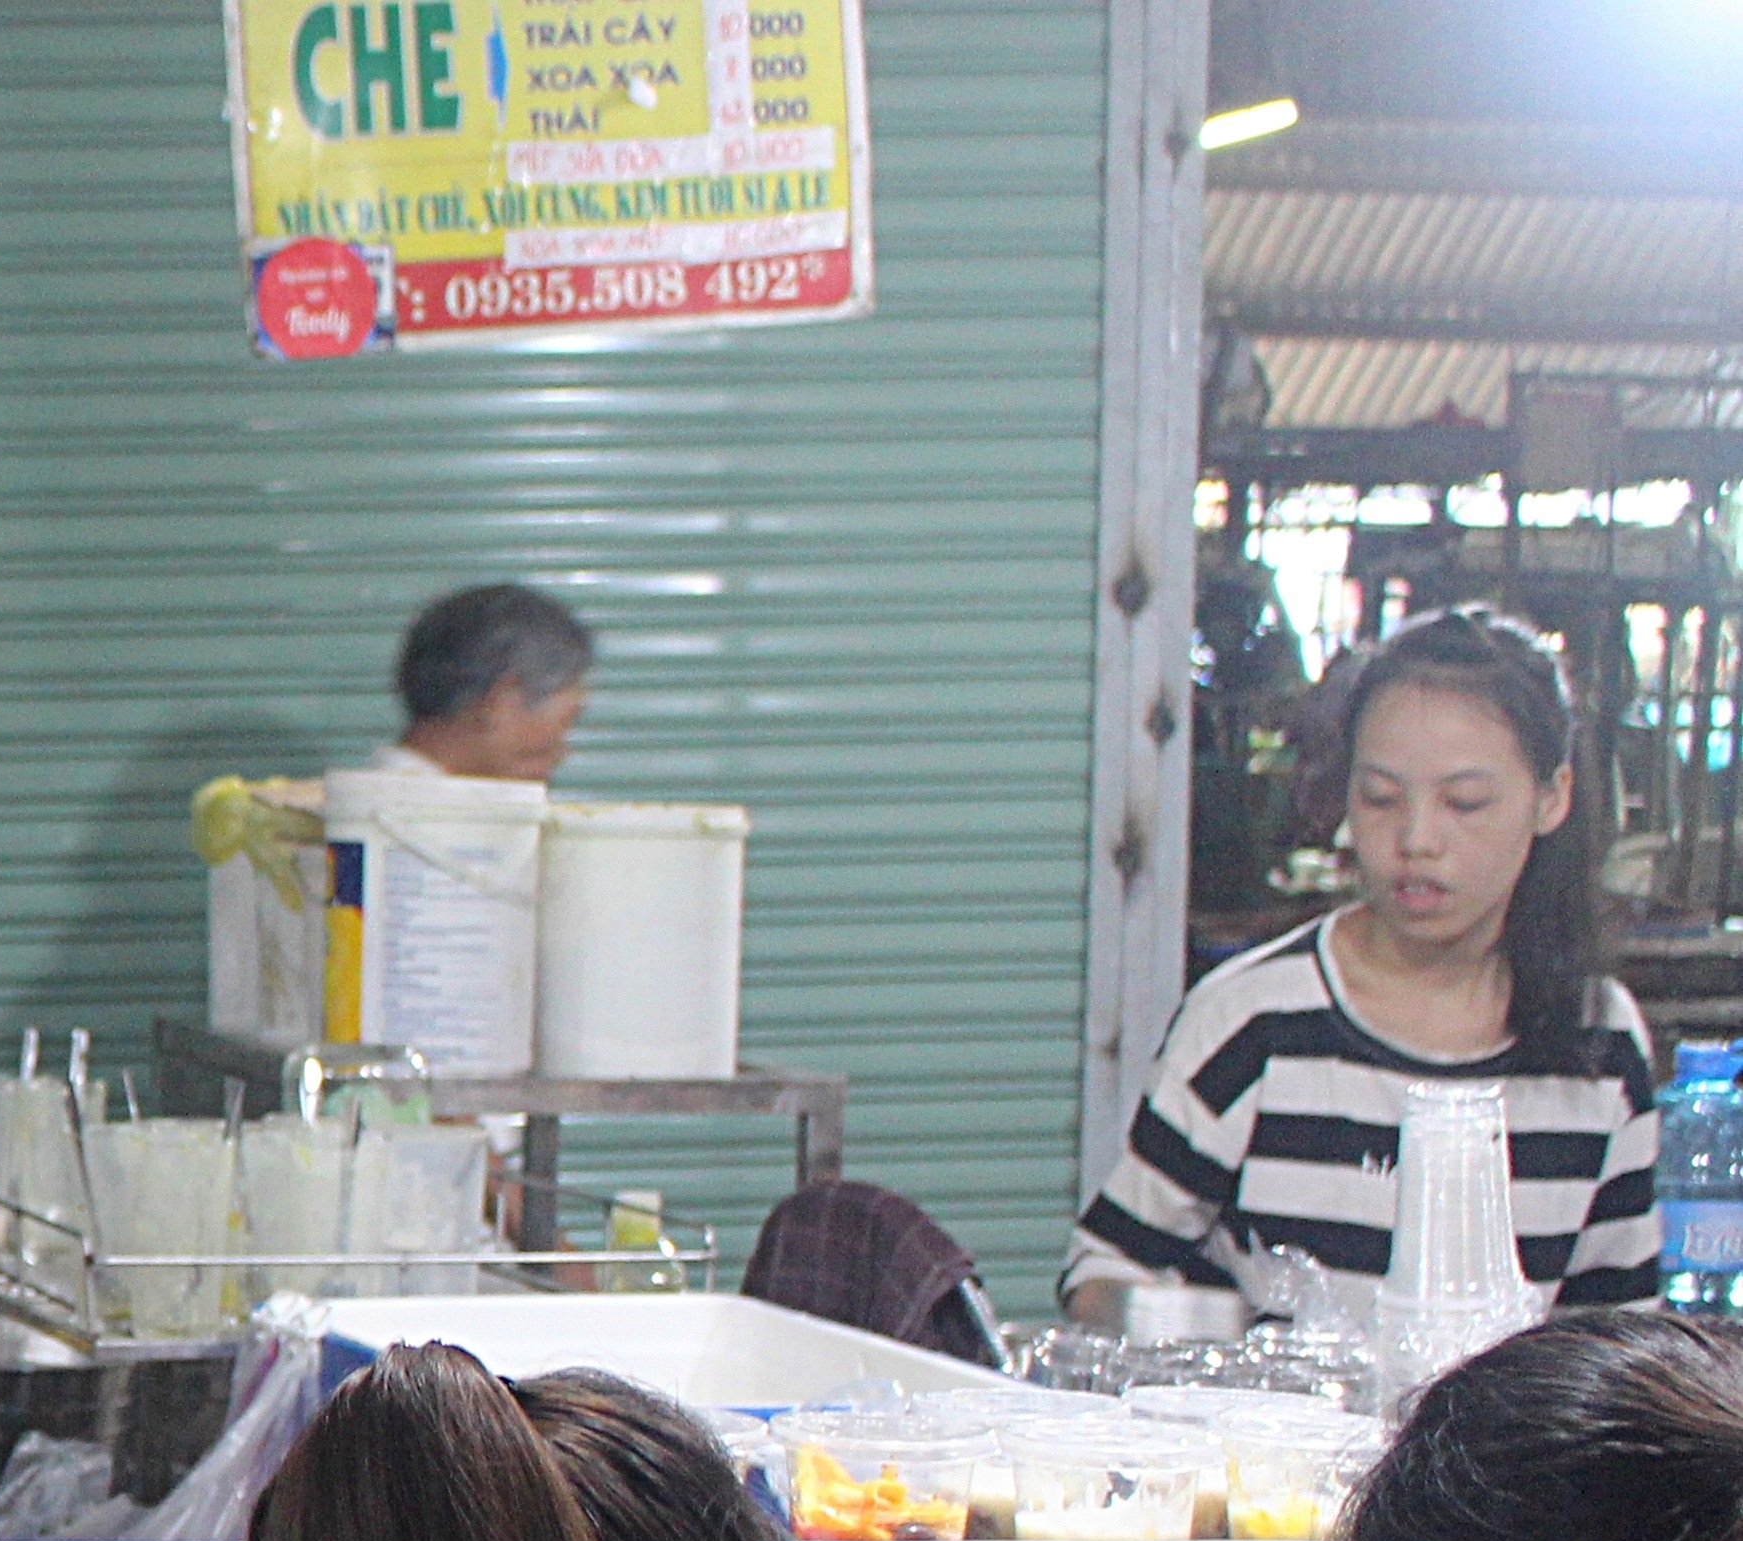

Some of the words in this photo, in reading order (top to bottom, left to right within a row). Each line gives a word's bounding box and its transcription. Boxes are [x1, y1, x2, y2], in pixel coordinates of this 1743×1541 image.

[523, 9, 592, 47] TRÁI
[602, 11, 676, 46] CÂY
[527, 62, 598, 92] XOA
[609, 59, 682, 88] XOA
